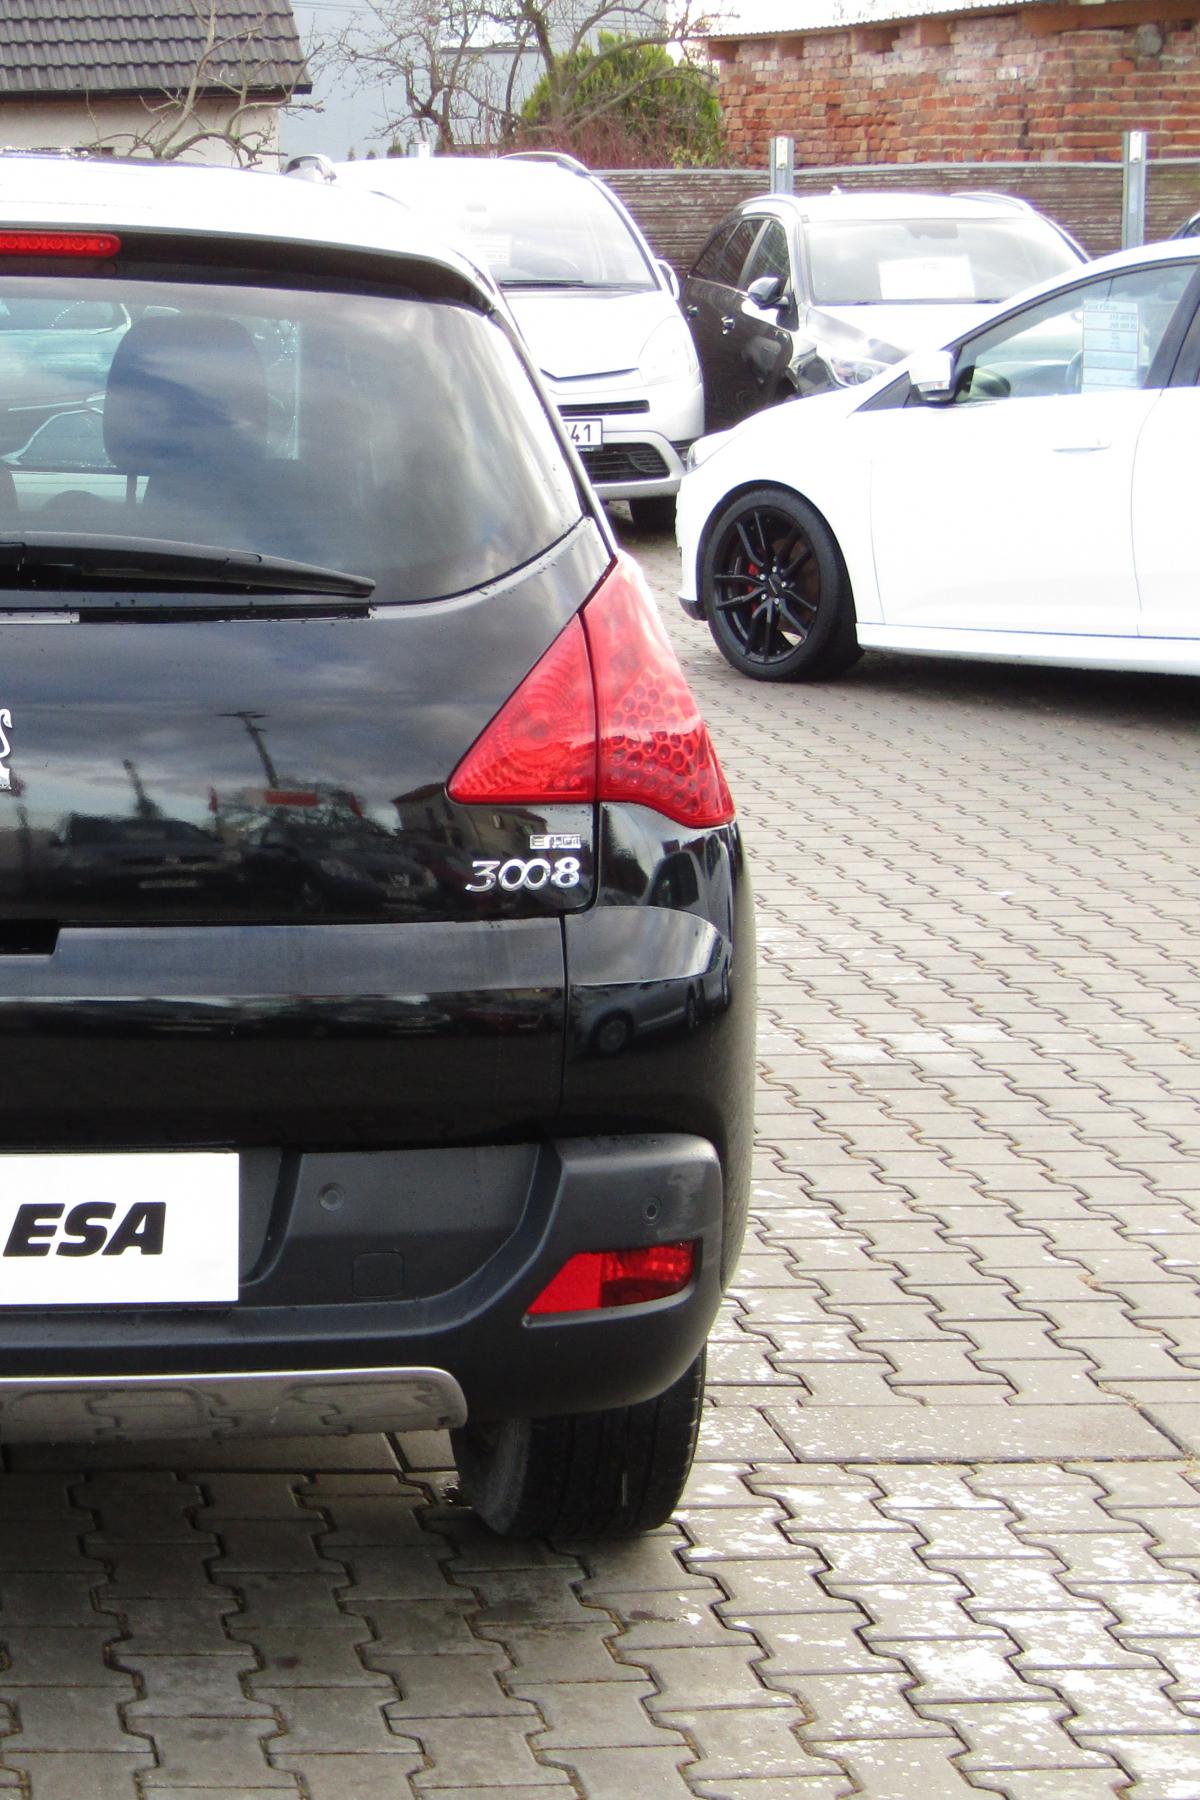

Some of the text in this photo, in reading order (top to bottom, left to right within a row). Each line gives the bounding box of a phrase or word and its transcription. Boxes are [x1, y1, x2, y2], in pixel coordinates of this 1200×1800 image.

[565, 423, 592, 443] 41
[464, 856, 582, 893] 3008
[2, 1201, 168, 1258] ESA
